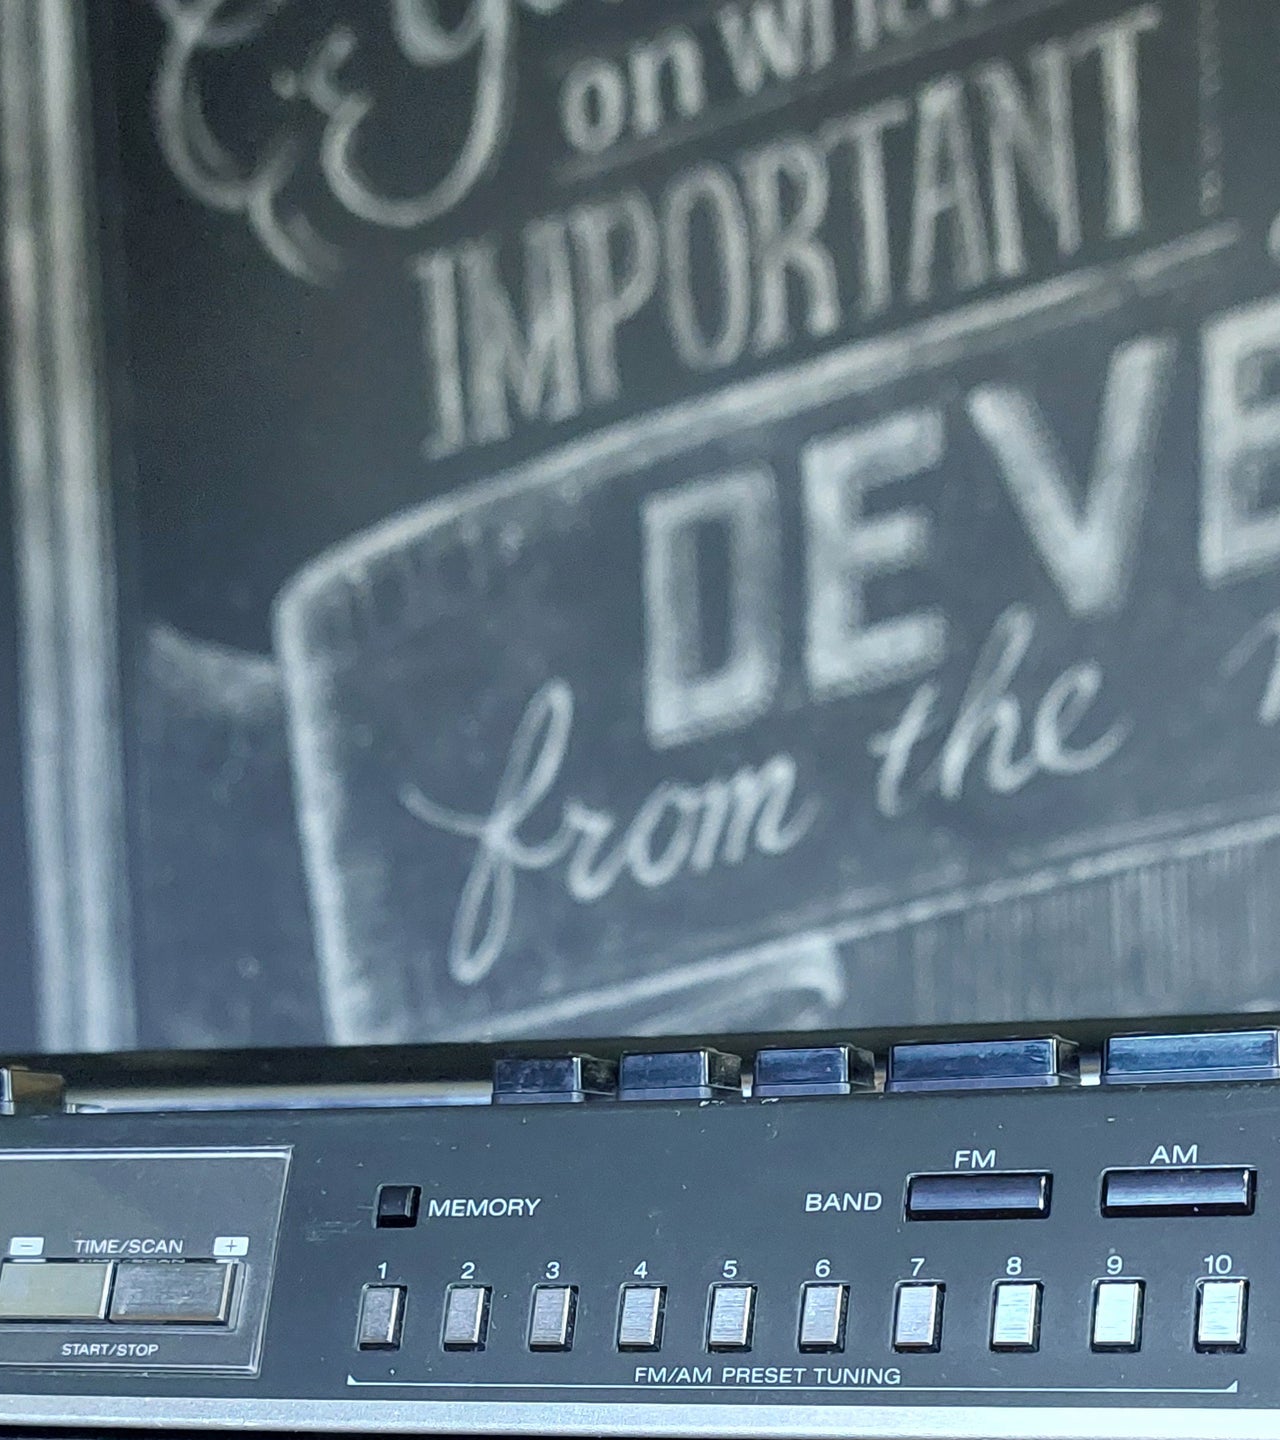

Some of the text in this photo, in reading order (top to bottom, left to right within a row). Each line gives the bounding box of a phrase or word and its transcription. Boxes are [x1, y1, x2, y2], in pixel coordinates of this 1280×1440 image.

[560, 25, 708, 155] on
[417, 8, 1160, 460] IMPORTANT
[400, 678, 818, 986] from
[870, 610, 1130, 816] the
[954, 1150, 996, 1169] FM
[1150, 1145, 1198, 1164] AM
[428, 1198, 541, 1218] MEMORY
[805, 1192, 882, 1213] BAND
[74, 1240, 183, 1254] TIME/SCAN
[377, 1255, 1233, 1280] 1 2 3 4 5 6 7 8 9 10
[62, 1344, 159, 1357] START/STOP
[634, 1367, 901, 1385] FM/AM PRESET TUNING
